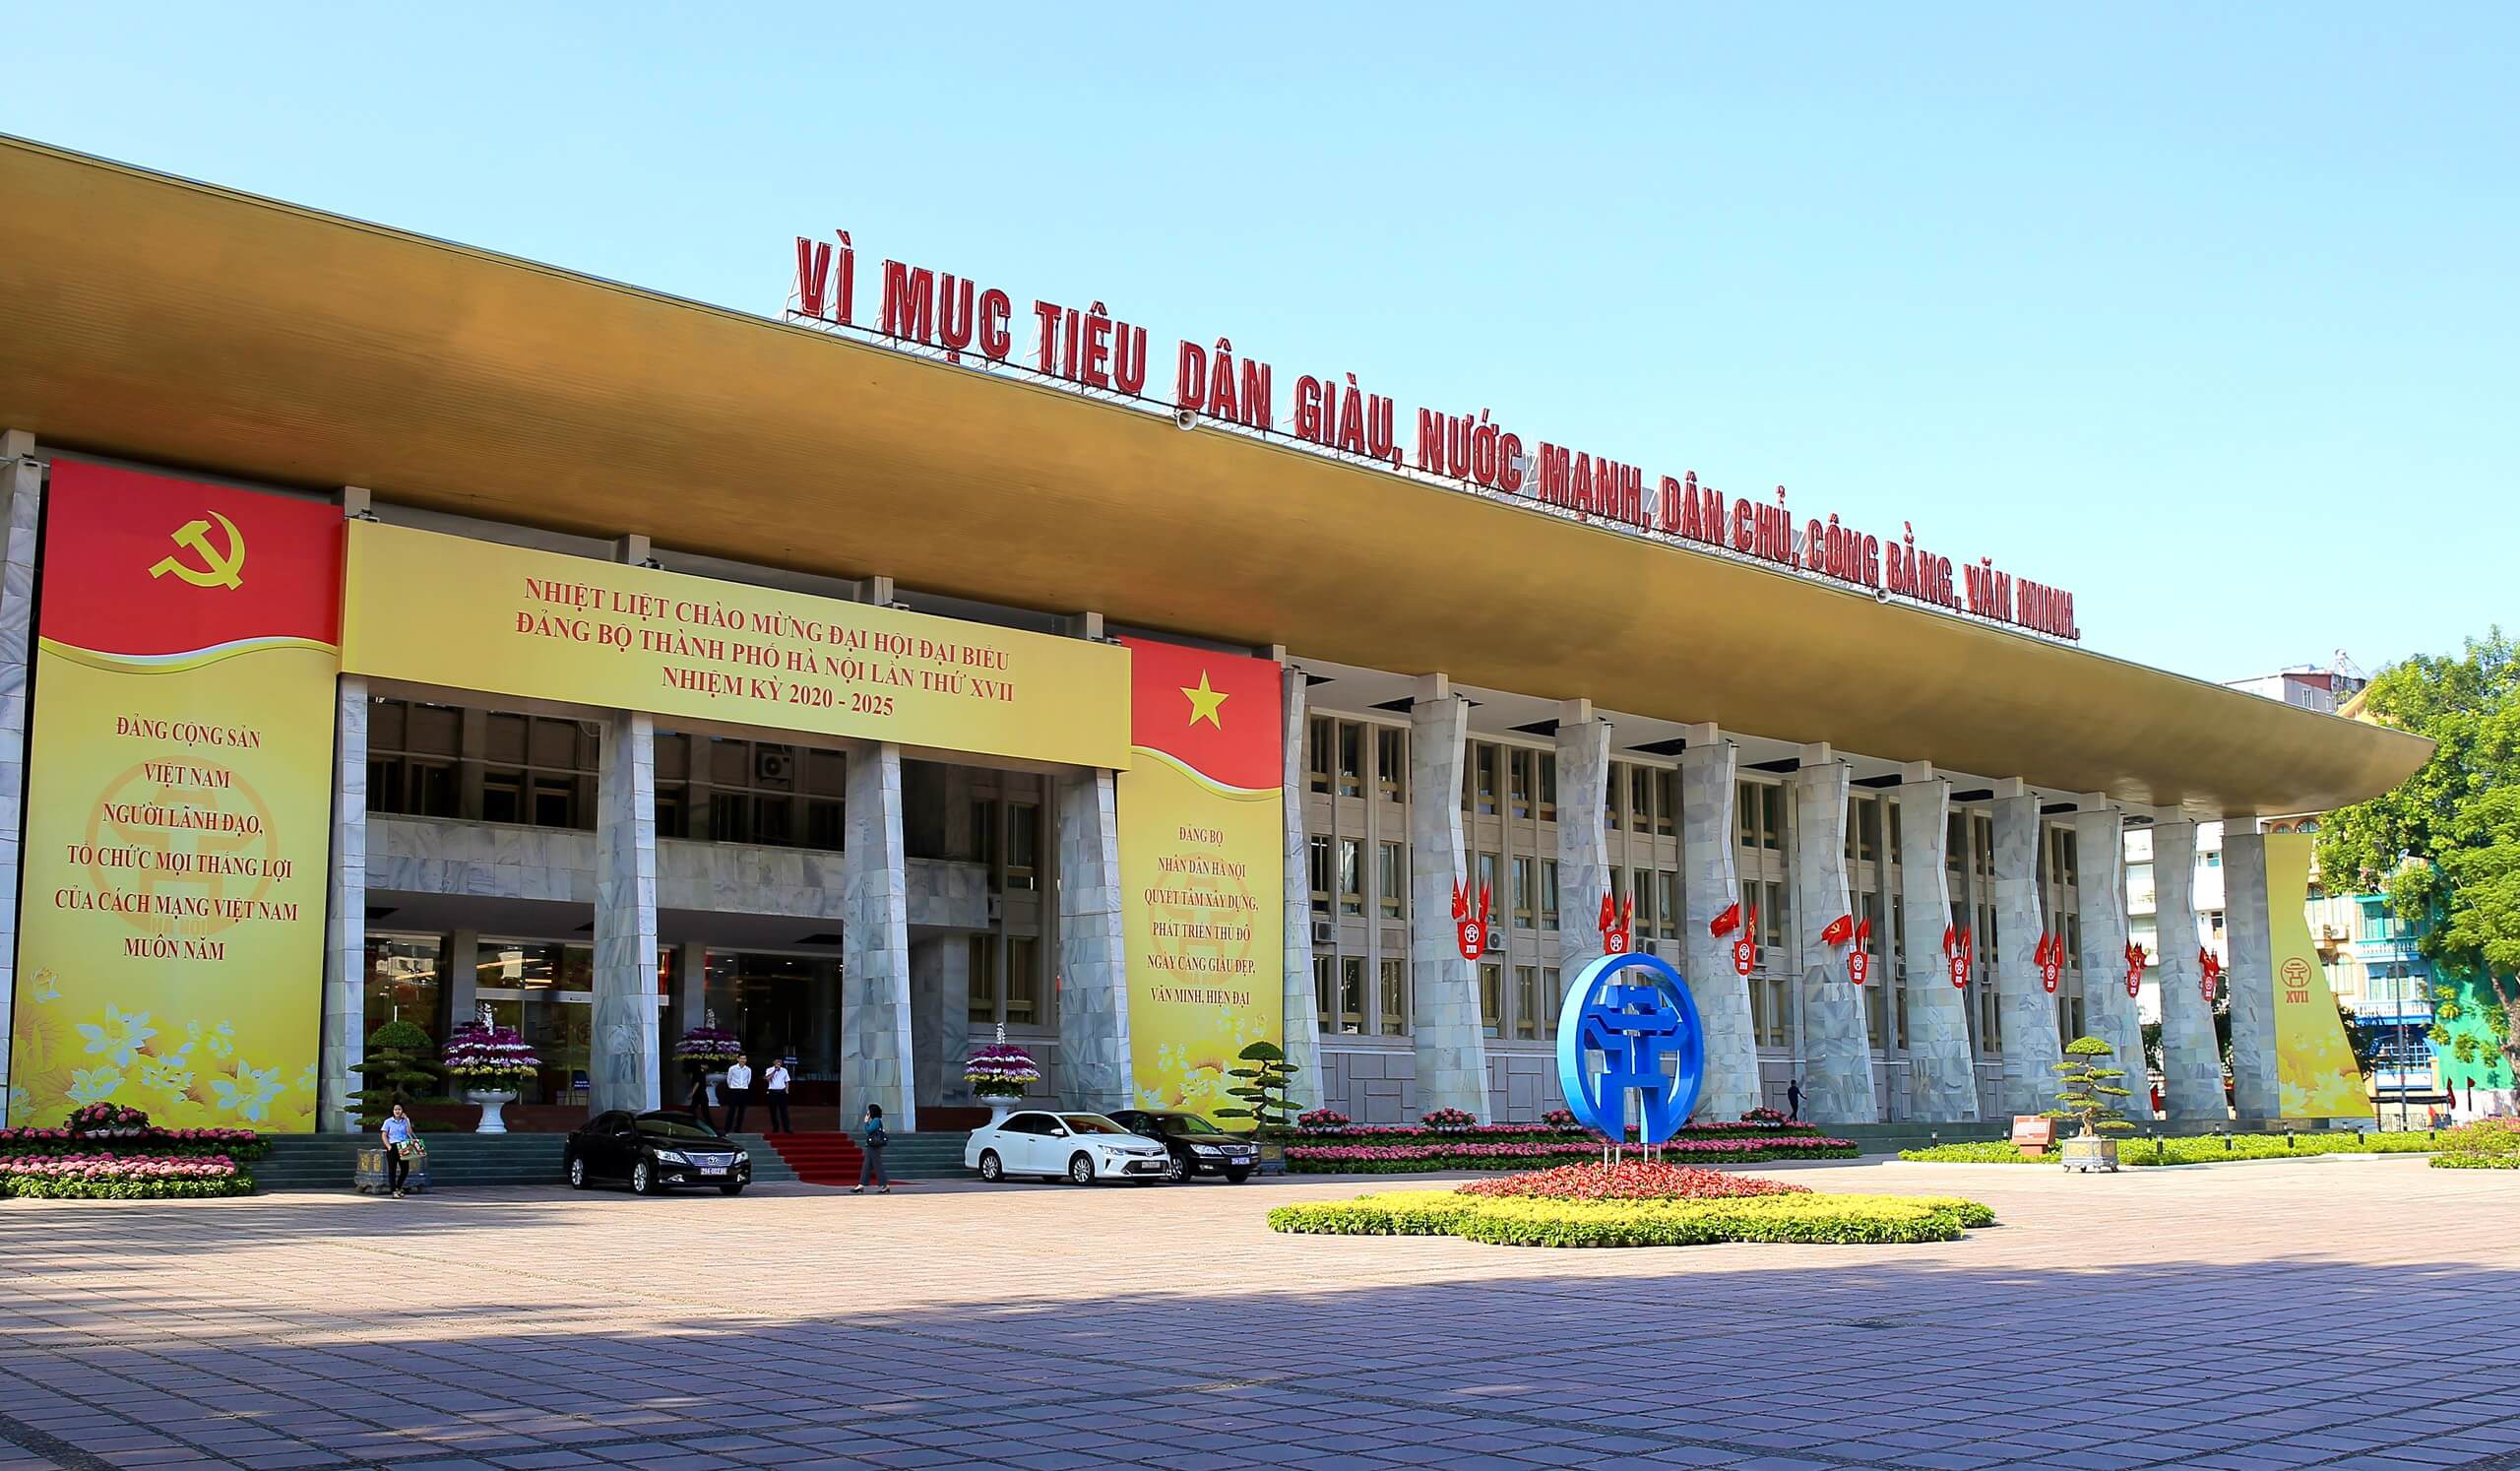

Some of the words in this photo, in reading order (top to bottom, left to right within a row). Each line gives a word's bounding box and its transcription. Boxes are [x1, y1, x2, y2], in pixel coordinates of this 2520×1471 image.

[795, 228, 854, 325] VÌ
[881, 258, 1012, 364] MỤC
[1034, 300, 1147, 394] TIÊU
[1177, 337, 1272, 430] DÂN
[1294, 372, 1403, 471] GIÀU,
[1418, 407, 1523, 493] NƯỚC
[1538, 441, 1651, 533] MẠNH,
[1660, 470, 1725, 545] DÂN
[1732, 485, 1800, 571] CHỦ,
[1806, 513, 1879, 589] CÔNG
[1885, 521, 1962, 614] BẰNG,
[1963, 556, 2011, 621] VĂN
[525, 577, 605, 612] NHIỆT
[612, 591, 669, 622] LIỆT
[675, 601, 745, 630] CHÀO
[750, 610, 823, 643] MỪNG
[829, 624, 867, 653] ĐẠI
[873, 631, 914, 659] HỘI
[919, 639, 956, 667] ĐẠI
[962, 644, 1010, 671] BIỂU
[515, 608, 591, 642] ĐẢNG
[598, 622, 632, 653] BỘ
[638, 628, 725, 661] THÀNH
[731, 641, 781, 670] PHỐ
[787, 648, 819, 673] HÀ
[825, 656, 865, 684] NỘI
[871, 660, 914, 688] LẦN
[919, 670, 967, 695] THỨ
[971, 677, 1014, 703] XVII
[662, 666, 744, 698] NHIỆM
[750, 675, 784, 703] KỲ
[789, 683, 834, 709] 2020
[851, 692, 894, 716] 2025
[116, 713, 167, 739] ĐẢNG
[172, 721, 222, 747] CỘNG
[227, 725, 261, 749] SẢN
[144, 762, 187, 788] VIỆT
[190, 767, 230, 789] NAM
[102, 801, 165, 827] NGƯỜI
[168, 805, 218, 831] LÃNH
[221, 812, 263, 837] ĐẠO,
[67, 841, 94, 866] TỔ
[97, 844, 152, 869] CHỨC
[156, 851, 192, 876] MỌI
[262, 859, 292, 883] LỢI
[1158, 854, 1186, 873] NHÂN
[1189, 856, 1210, 875] DÂN
[1212, 859, 1227, 876] HÀ
[1228, 861, 1245, 880] NỘI
[54, 884, 94, 910] CỦA
[98, 886, 151, 915] CÁCH
[155, 895, 210, 921] MẠNG
[214, 897, 255, 923] VIỆT
[258, 901, 298, 922] NAM
[1181, 887, 1203, 906] TÂM
[1206, 889, 1227, 908] XÂY
[1153, 918, 1182, 937] PHÁT
[1236, 924, 1251, 941] ĐÔ
[124, 933, 180, 959] MUÔN
[183, 937, 225, 961] NĂM
[1148, 951, 1176, 969] NGÀY
[1151, 985, 1172, 1002] VĂN
[1174, 989, 1204, 1003] MINH,
[1232, 991, 1249, 1008] ĐẠI
[2286, 990, 2308, 1003] XVII
